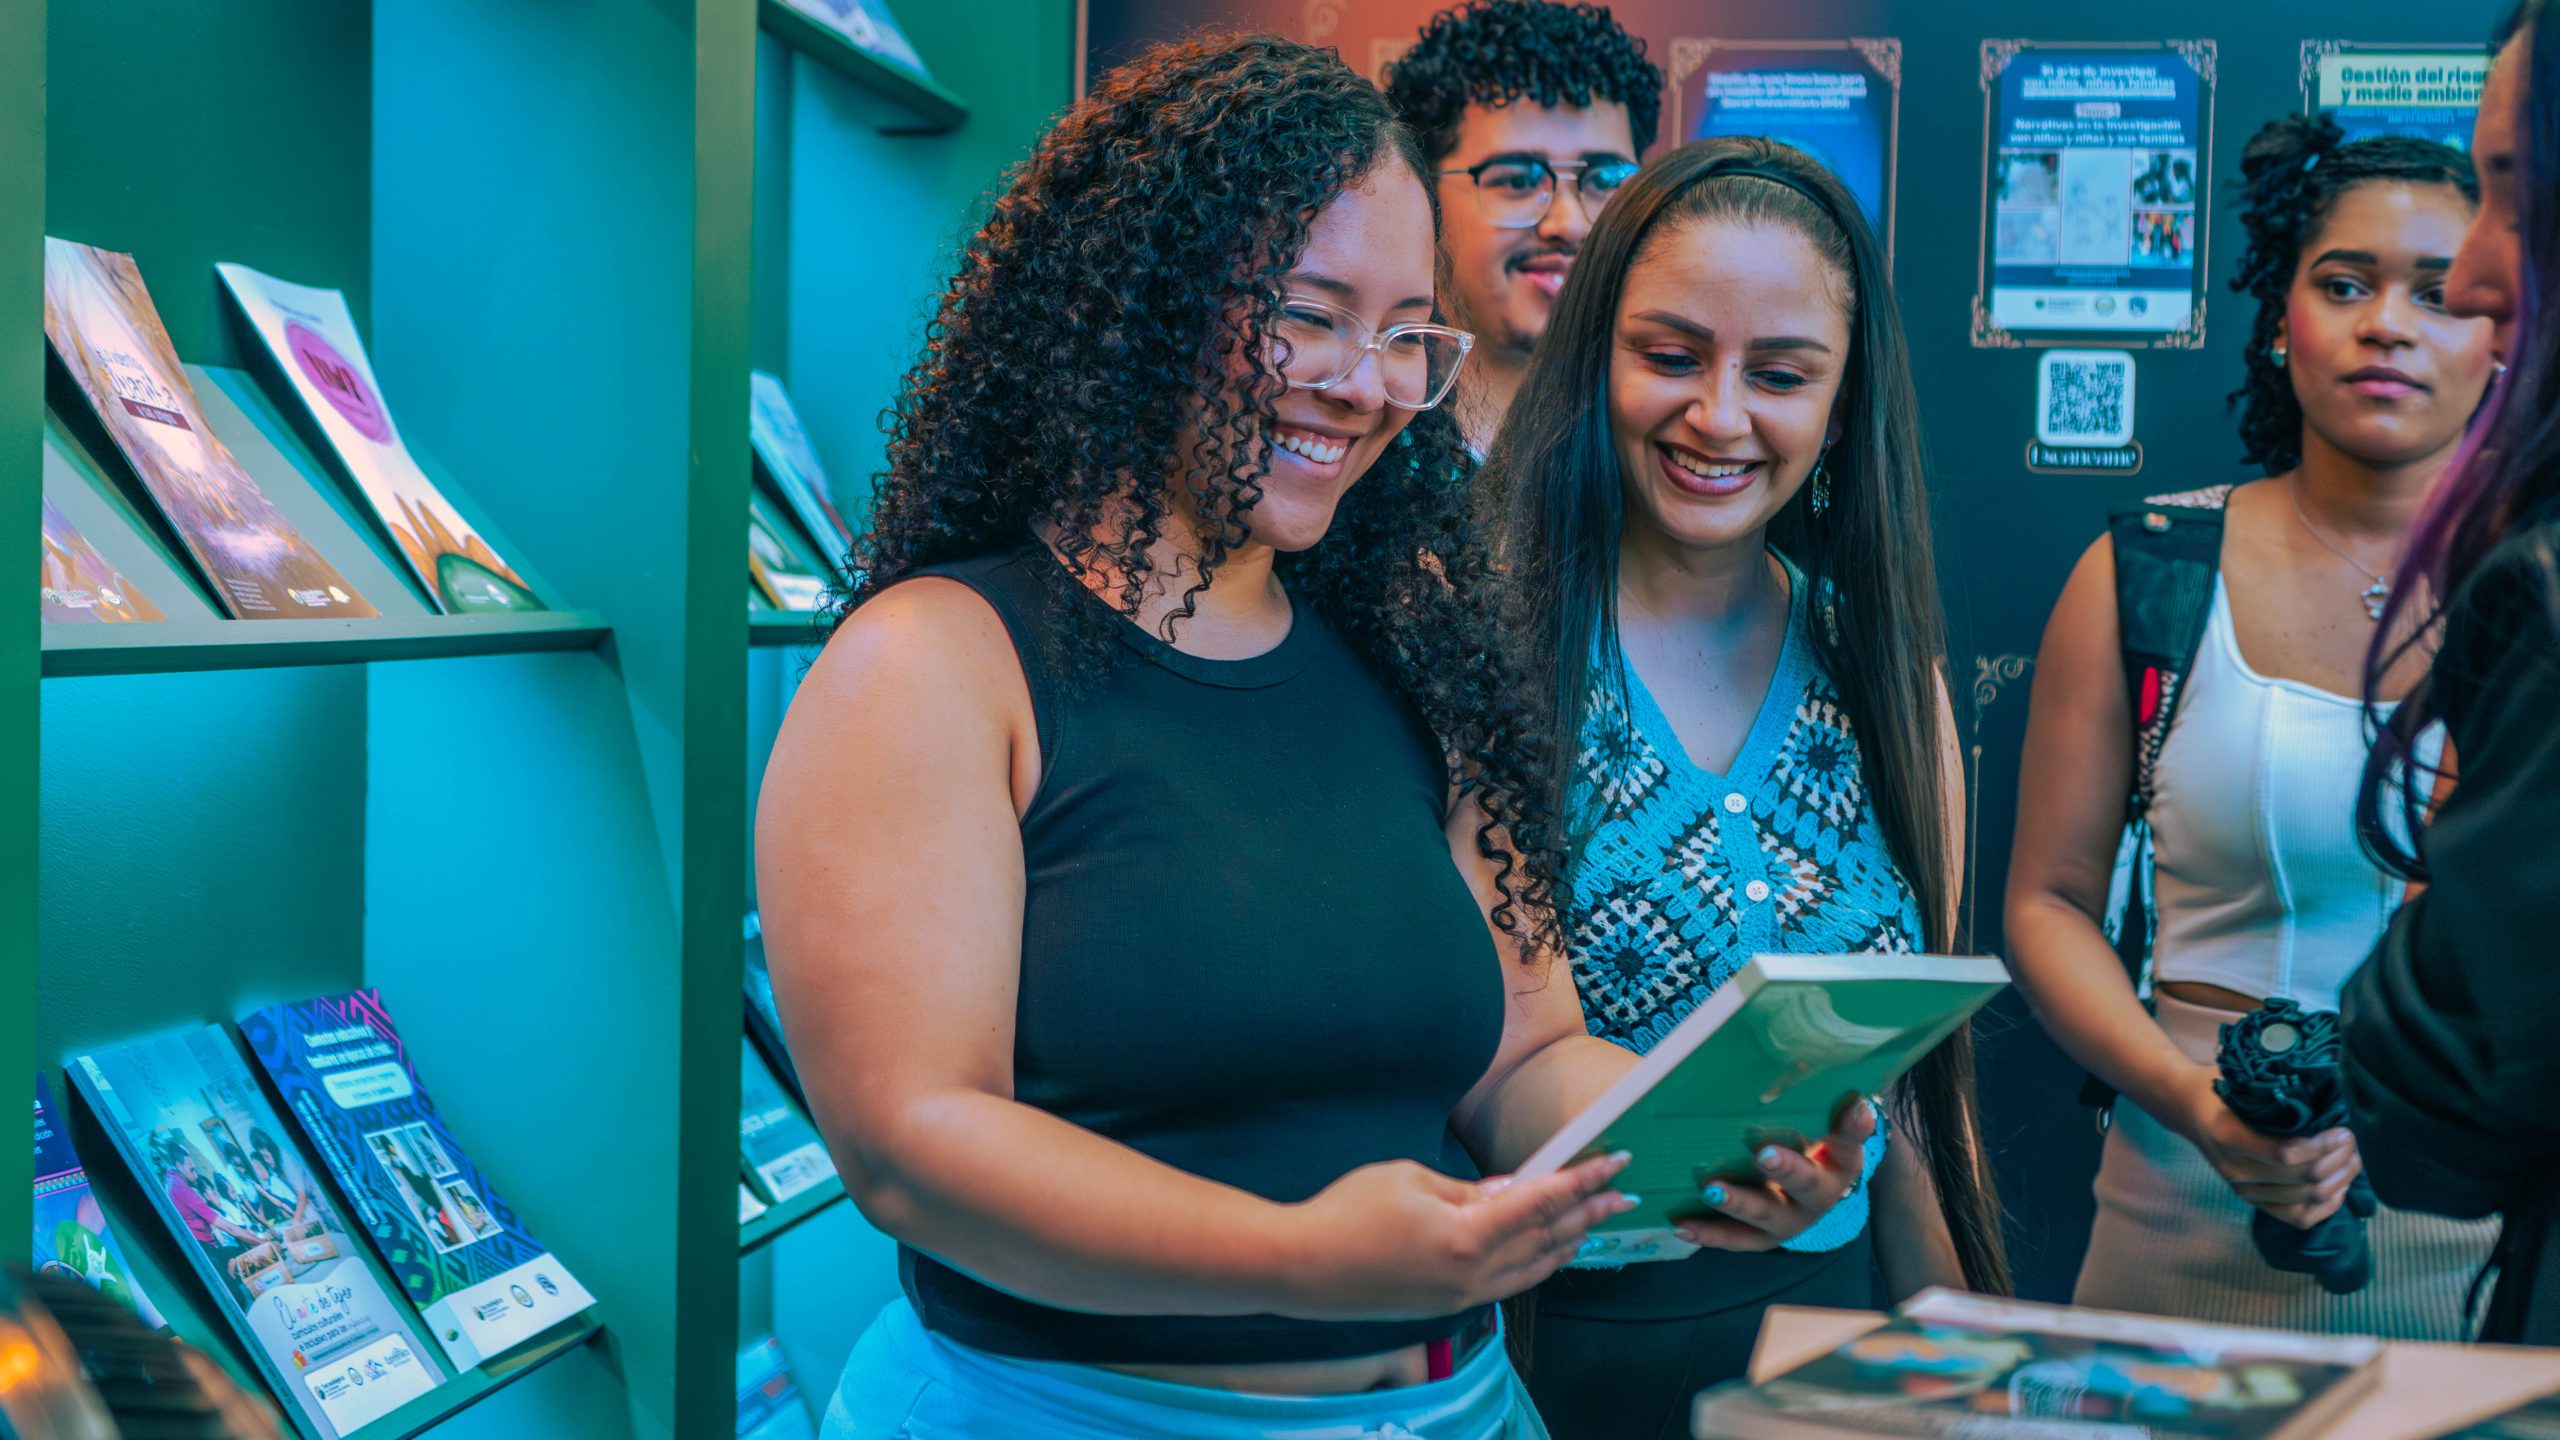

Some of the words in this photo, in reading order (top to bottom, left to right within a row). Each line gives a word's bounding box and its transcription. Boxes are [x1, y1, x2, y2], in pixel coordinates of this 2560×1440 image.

[2057, 65, 2080, 77] arte
[2083, 65, 2097, 77] de
[2341, 65, 2411, 84] Gestión
[2415, 65, 2444, 84] del
[2128, 78, 2175, 89] familias
[2341, 87, 2351, 106] y
[2355, 85, 2412, 101] medio
[2015, 119, 2074, 130] Narrativas
[2077, 121, 2091, 130] en
[2094, 119, 2104, 130] la
[2106, 117, 2181, 132] investigación
[2010, 134, 2031, 143] con
[2139, 132, 2185, 143] familias
[273, 1295, 296, 1331] El
[315, 1287, 331, 1310] de
[326, 1284, 352, 1315] tejer
